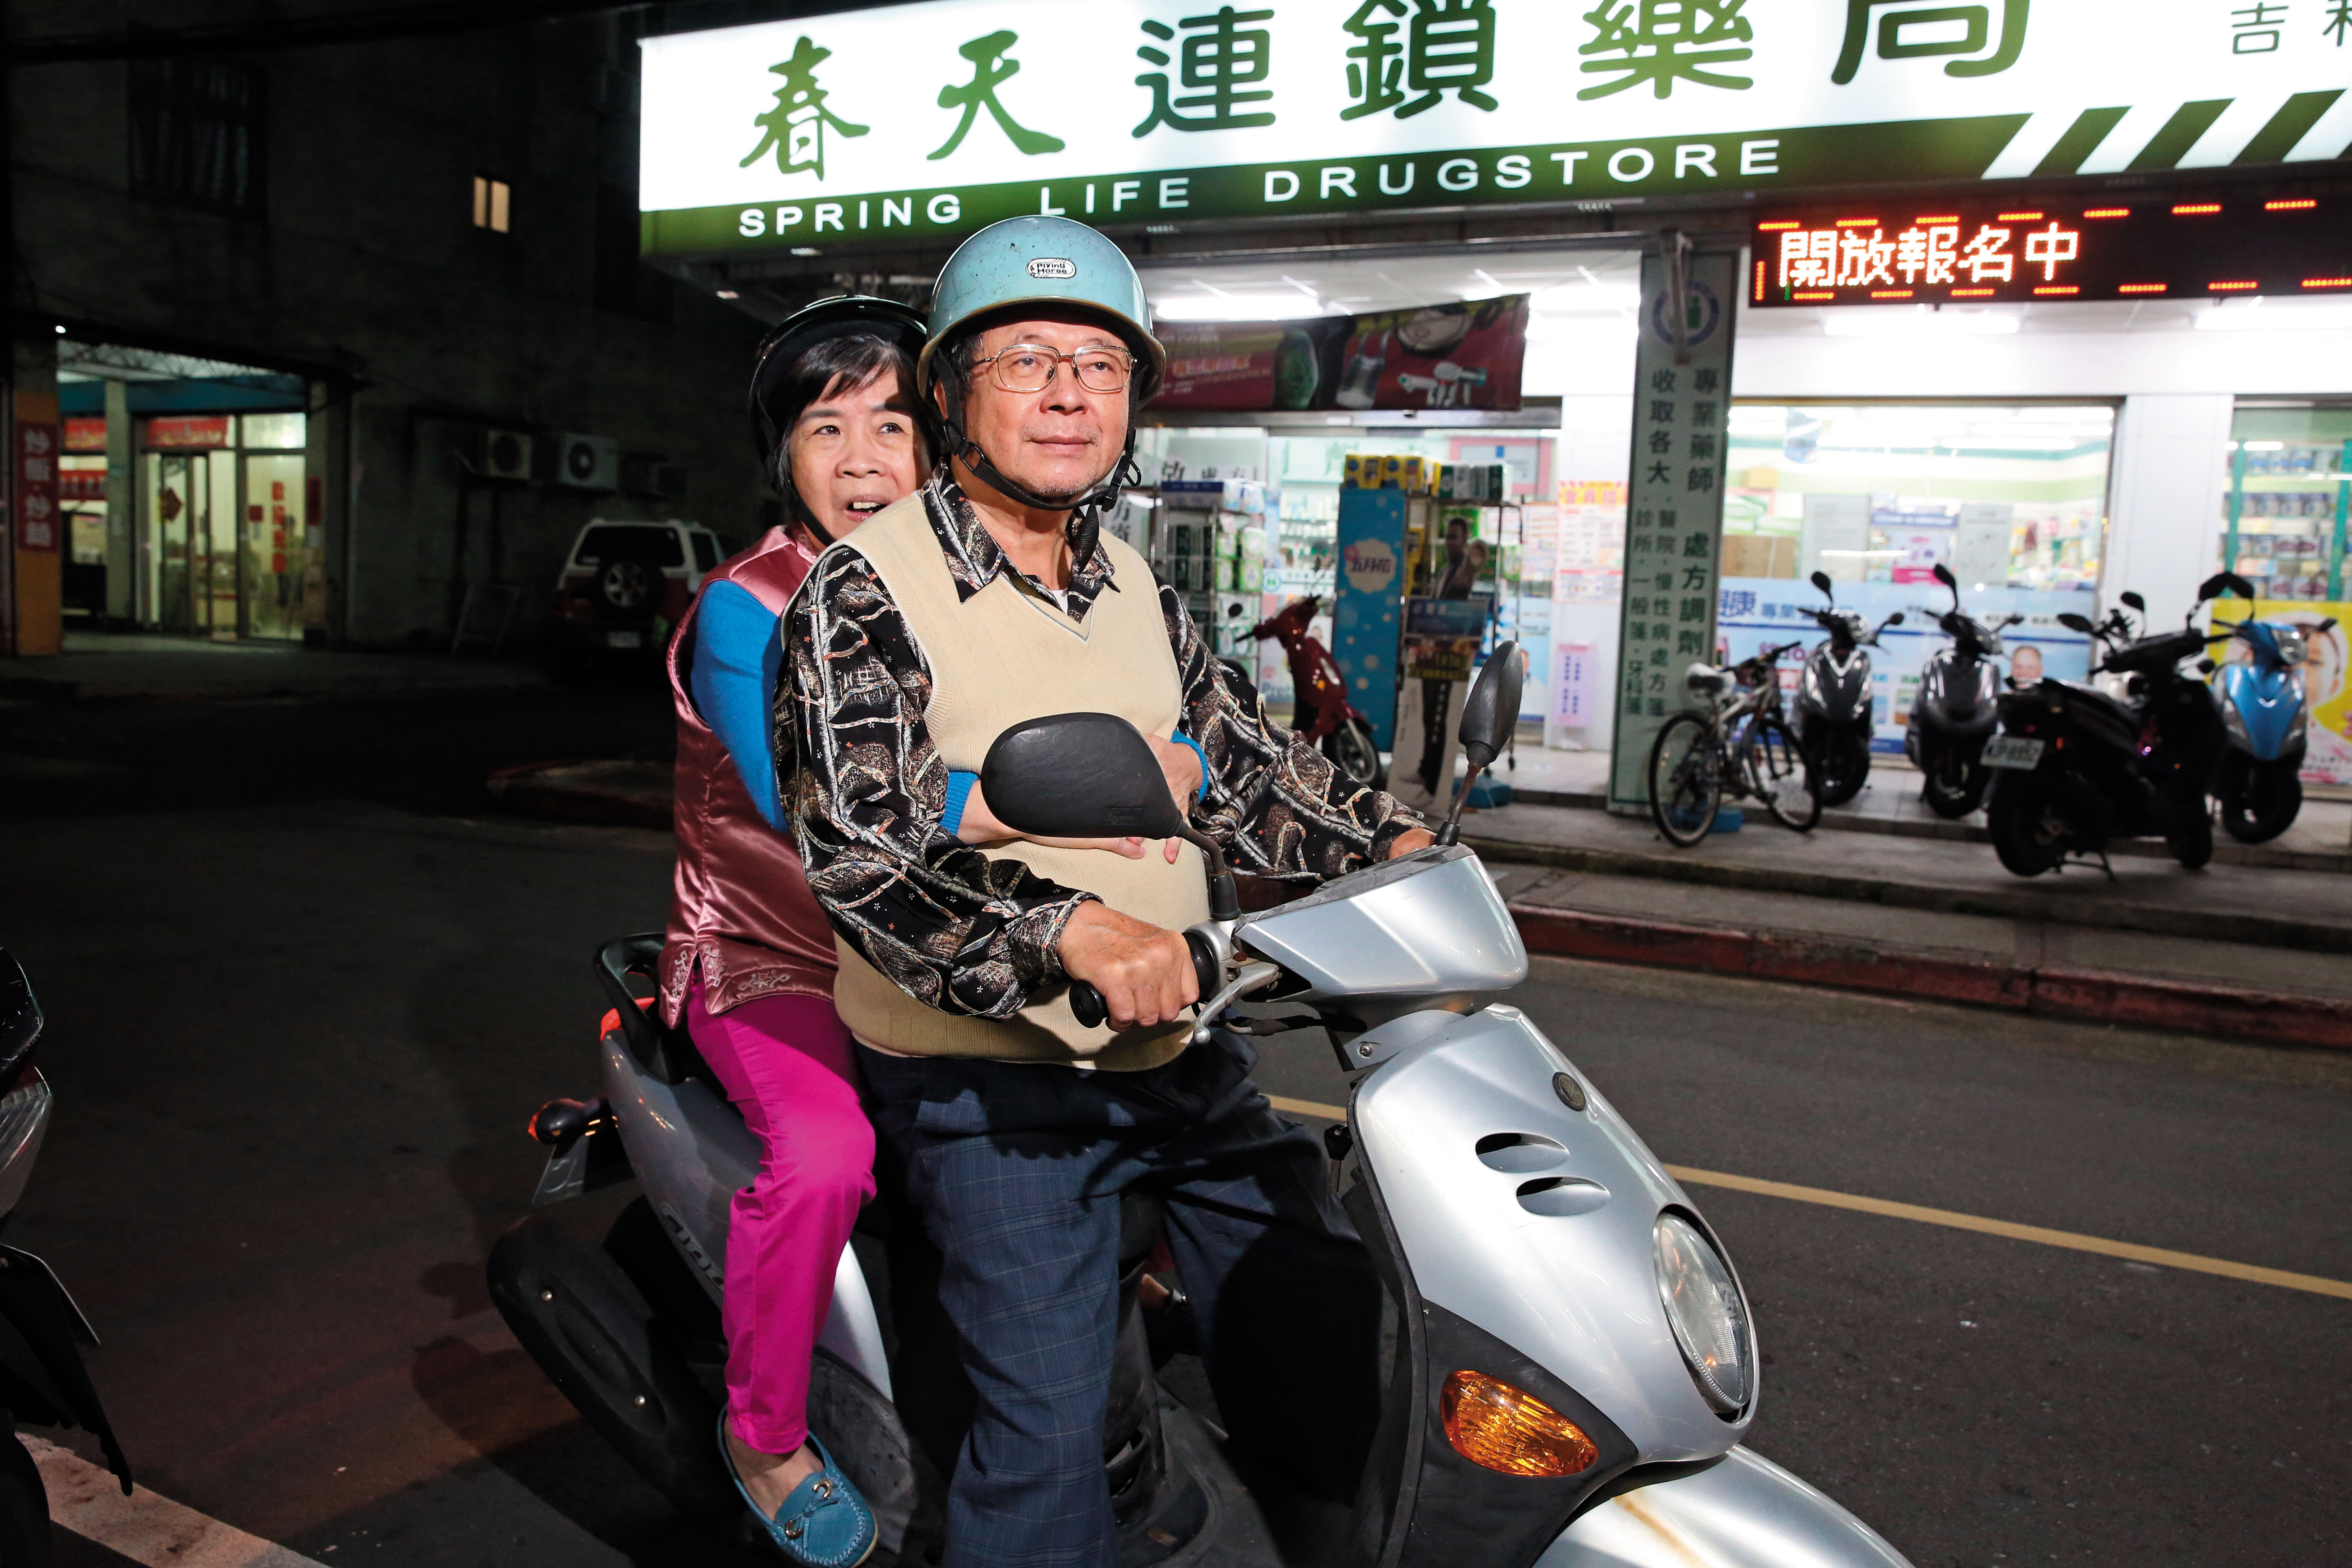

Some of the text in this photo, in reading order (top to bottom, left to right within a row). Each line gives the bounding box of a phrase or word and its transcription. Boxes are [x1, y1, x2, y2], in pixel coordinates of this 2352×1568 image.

[739, 138, 1780, 238] SPRING LIFE DRUGSTORE
[1780, 222, 2079, 287] 開放報名中
